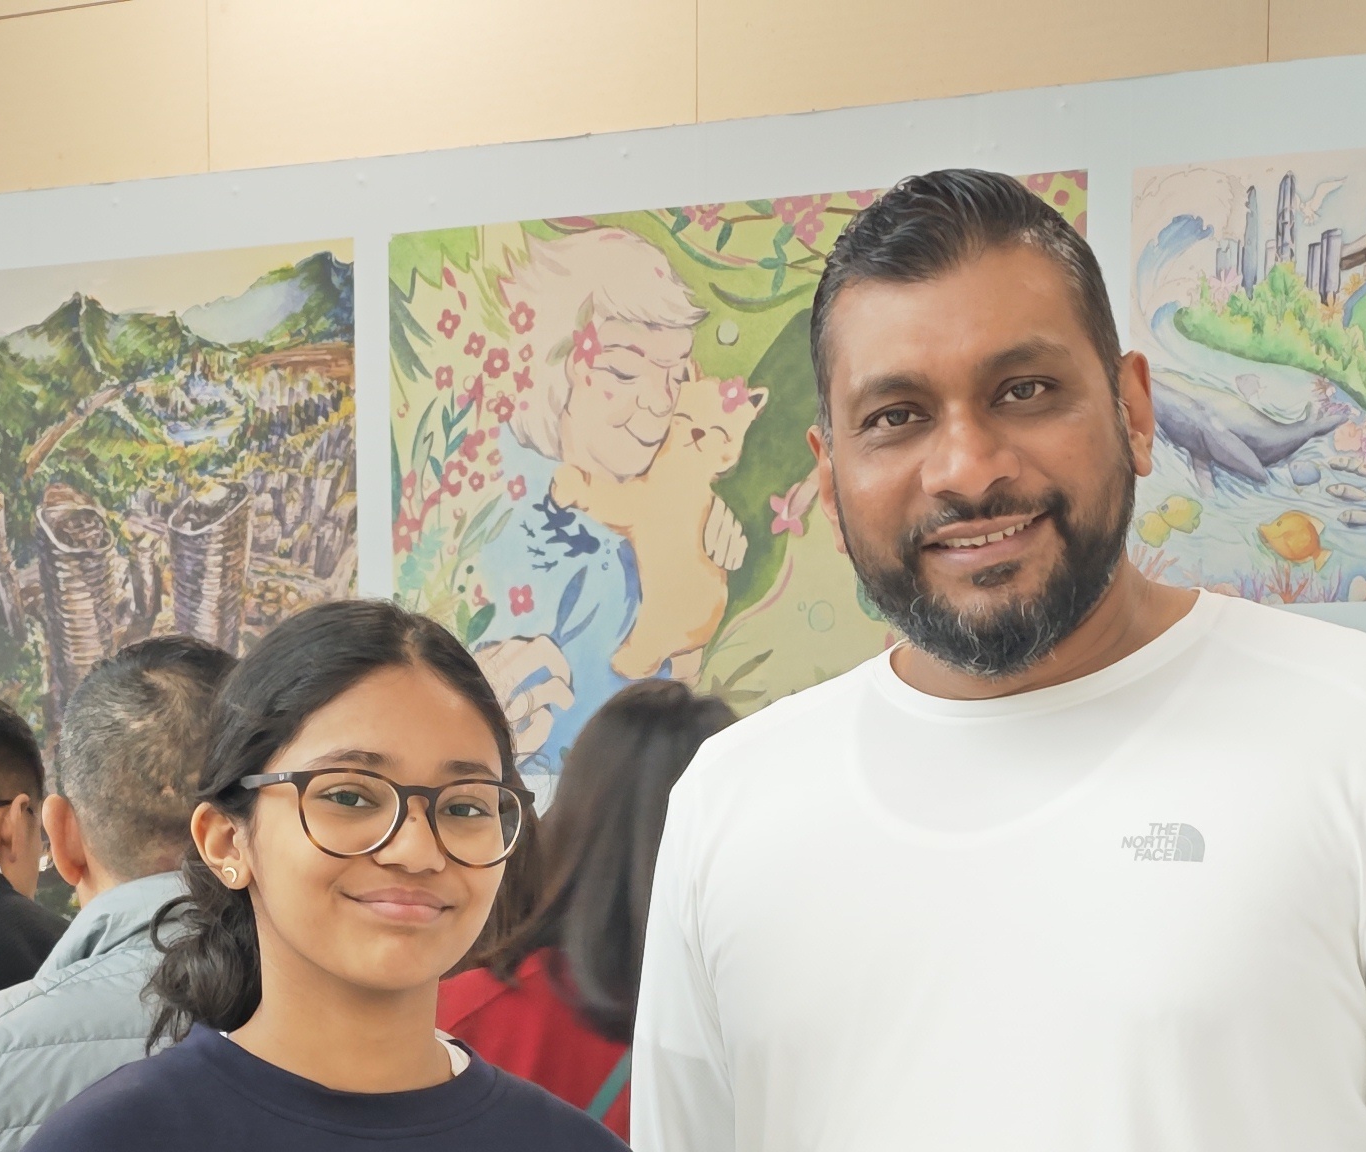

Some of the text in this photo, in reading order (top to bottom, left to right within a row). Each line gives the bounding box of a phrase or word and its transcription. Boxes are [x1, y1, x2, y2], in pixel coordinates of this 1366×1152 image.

[1148, 822, 1180, 835] THE
[1121, 835, 1176, 848] NORTH
[1134, 848, 1174, 862] FACE
